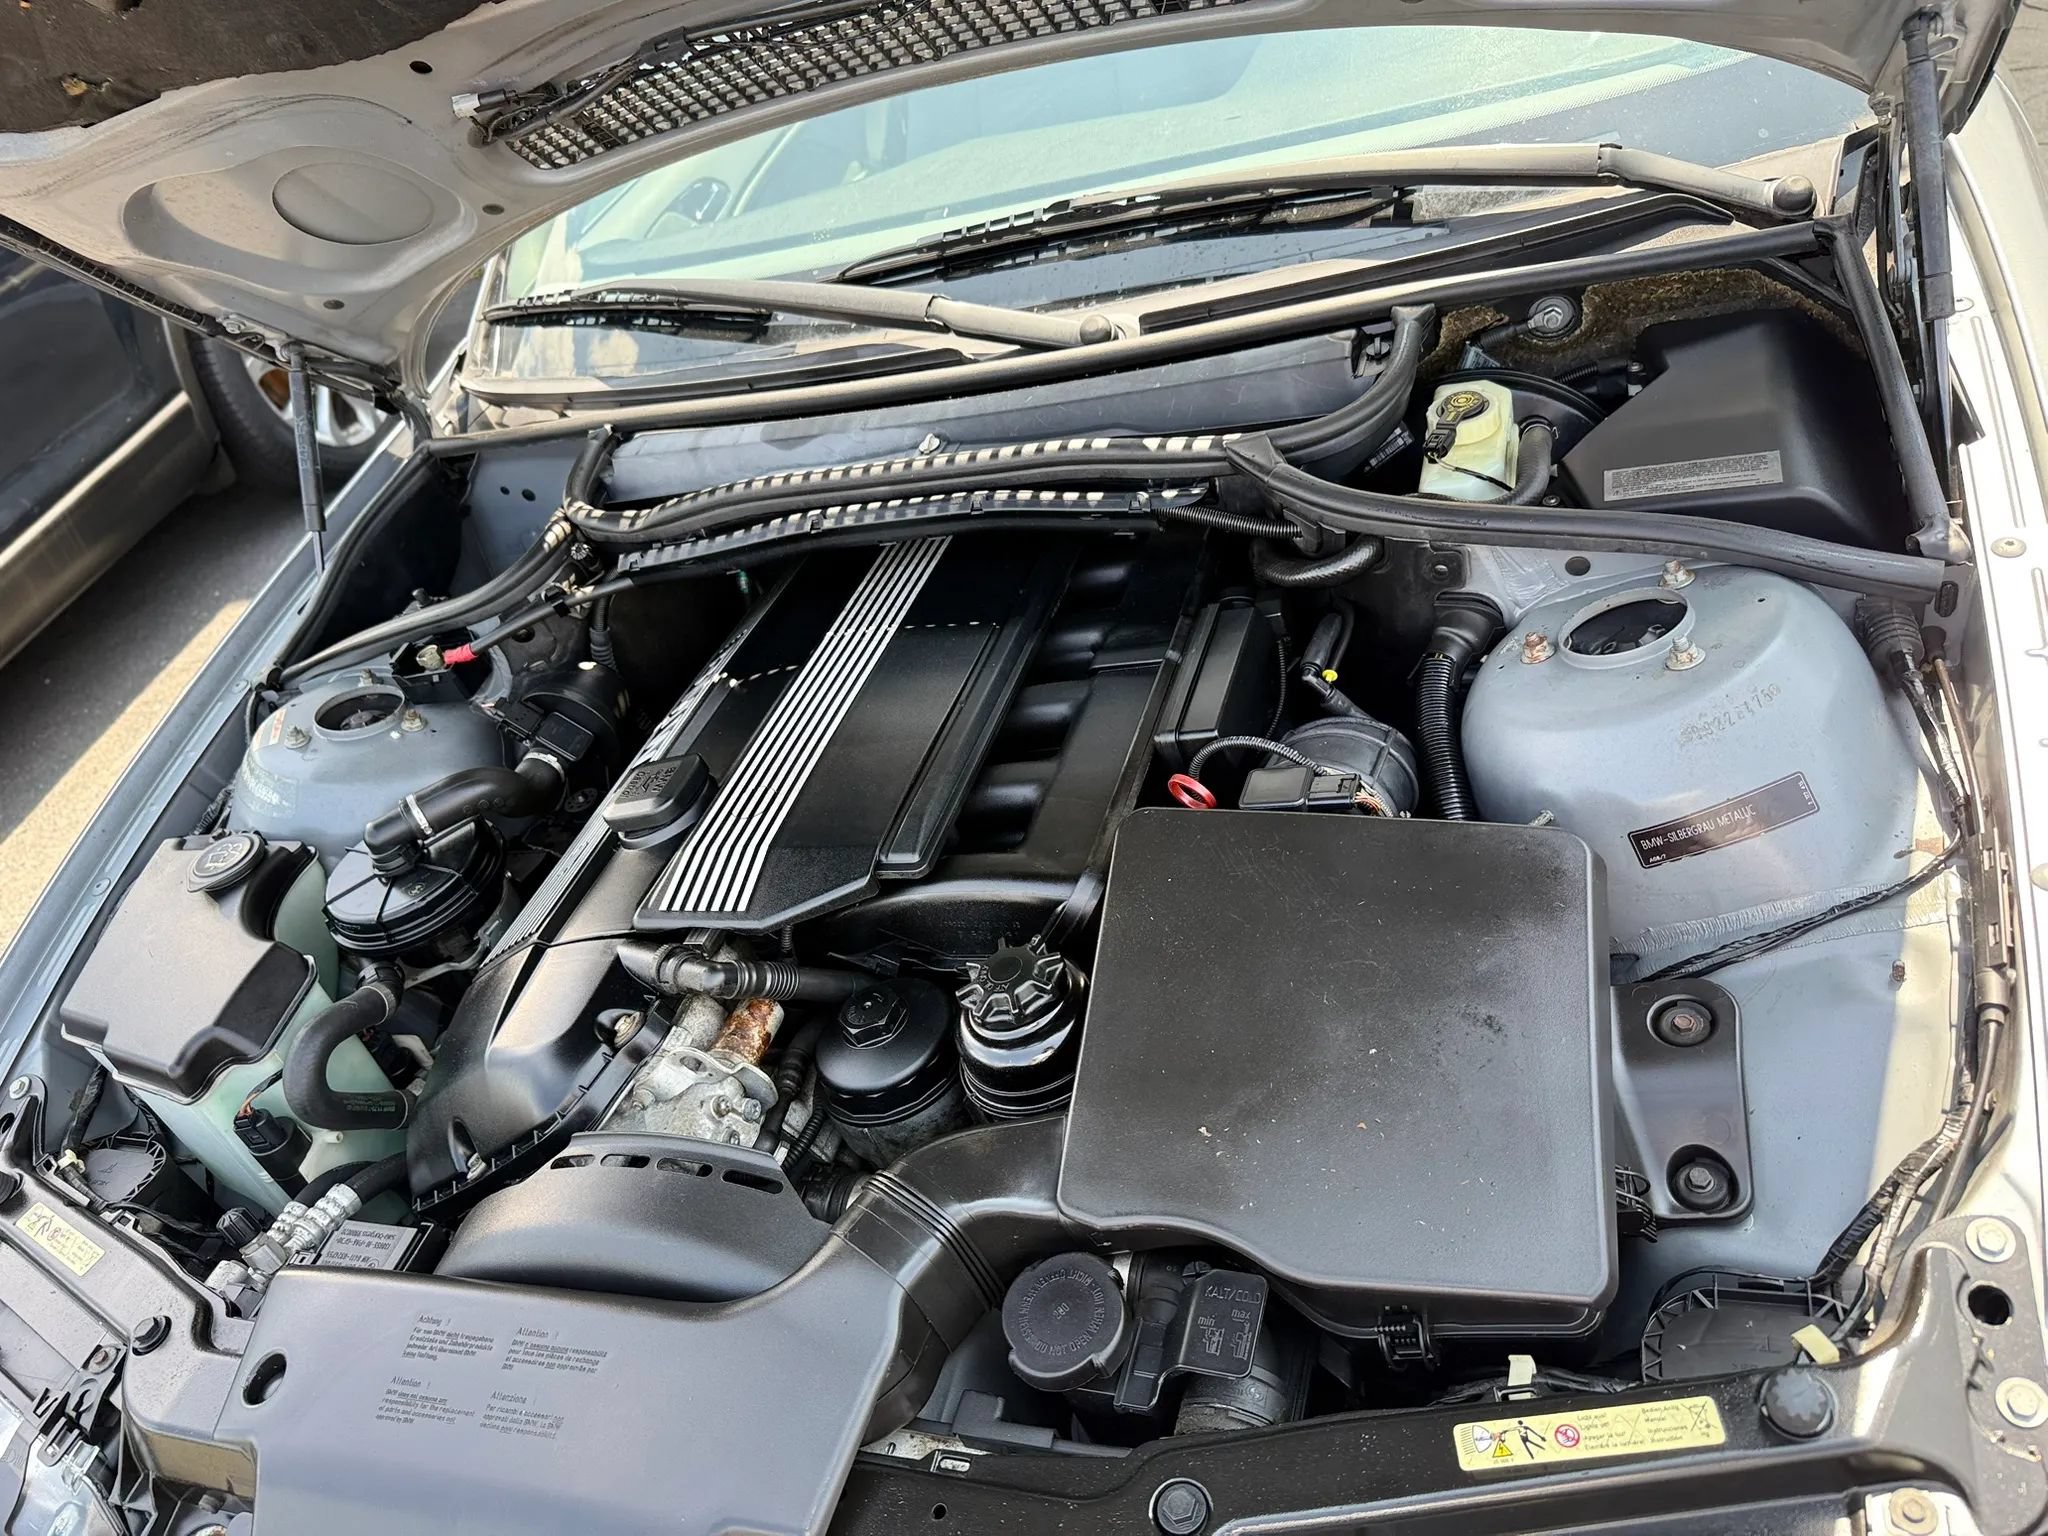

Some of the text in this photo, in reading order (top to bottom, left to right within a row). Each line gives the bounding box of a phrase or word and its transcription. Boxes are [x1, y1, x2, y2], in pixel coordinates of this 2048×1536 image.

[1640, 821, 1715, 850] BMW-SILBERGRAU
[1204, 1284, 1262, 1304] KALT/COLD
[1197, 1314, 1216, 1327] min
[1231, 1309, 1252, 1321] max
[1034, 1339, 1048, 1354] DO
[1070, 1331, 1093, 1352] OPEN
